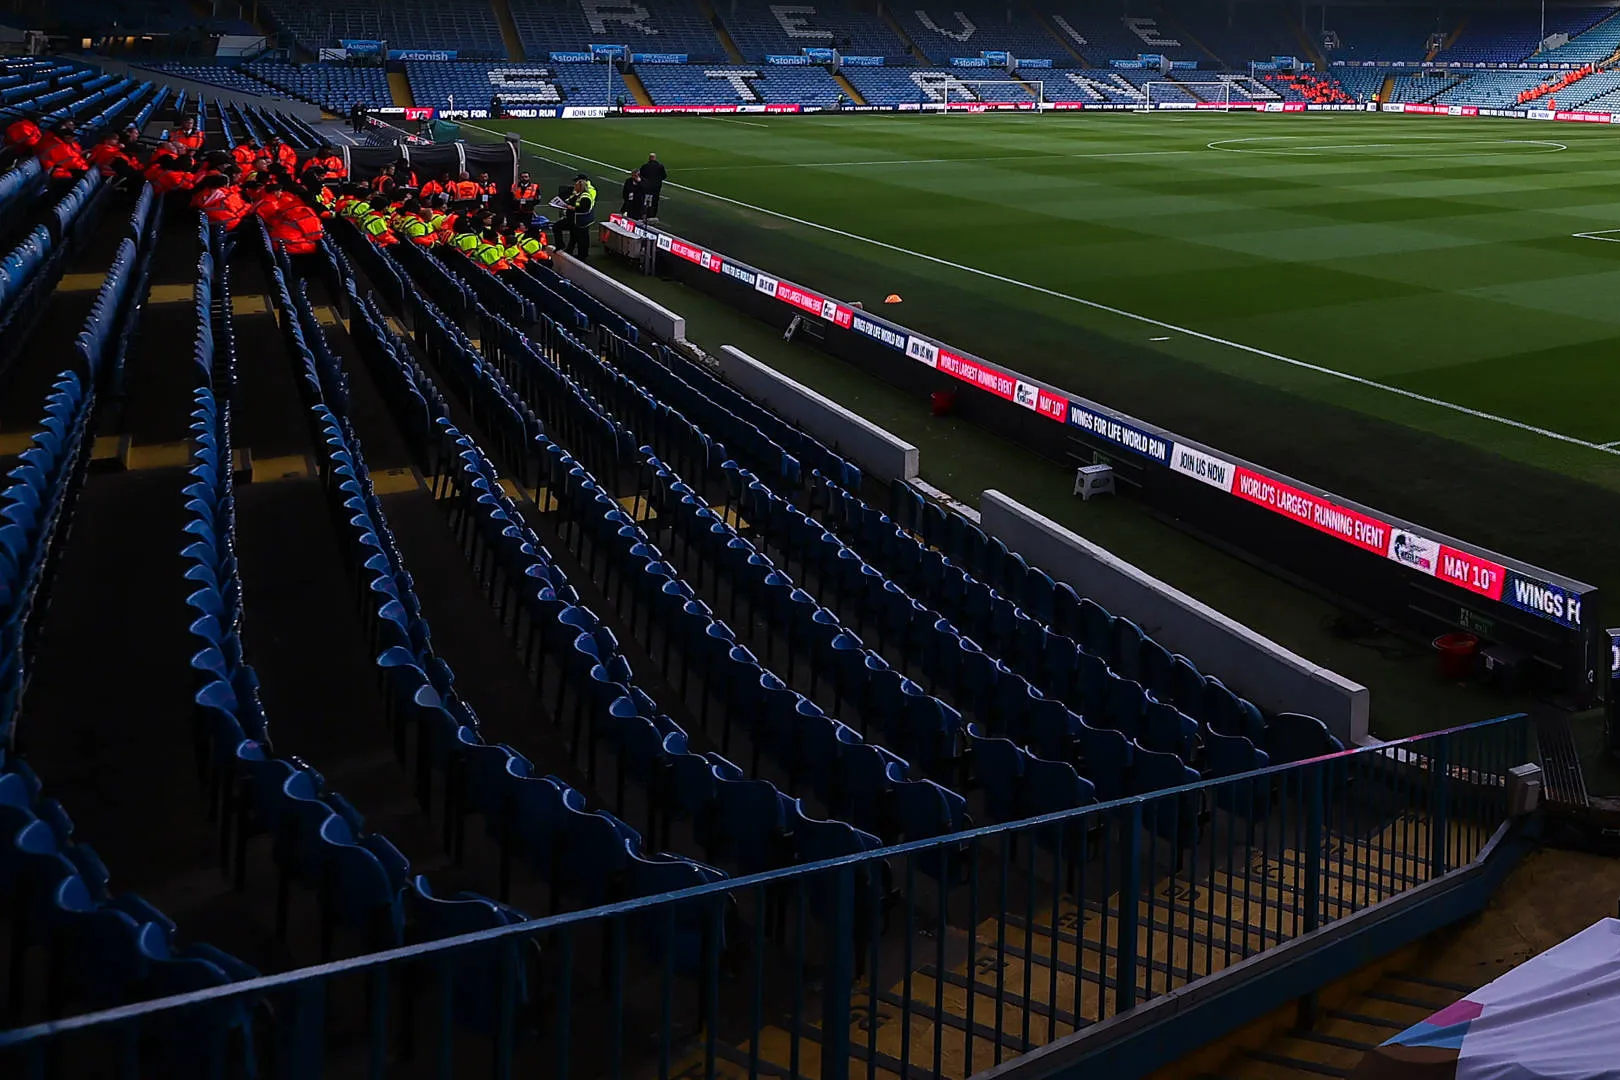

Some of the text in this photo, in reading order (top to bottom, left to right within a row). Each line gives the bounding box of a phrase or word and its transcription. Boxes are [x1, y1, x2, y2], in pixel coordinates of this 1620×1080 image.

[399, 51, 448, 62] Astonish
[551, 53, 591, 62] Astonish
[470, 110, 485, 118] FOR
[509, 110, 556, 118] WORLD RUN
[940, 355, 1012, 395] WORLD'S LARGEST RUNNING EVENT
[1040, 396, 1050, 412] MAY
[1072, 407, 1166, 460] WINGS FOR LIFE WORLD RUN
[1180, 452, 1225, 486] JOIN US NOW
[1240, 475, 1384, 548] WORLD'S LARGEST RUNNING EVENT
[1444, 555, 1470, 581] MAY
[1514, 578, 1564, 617] WINGS
